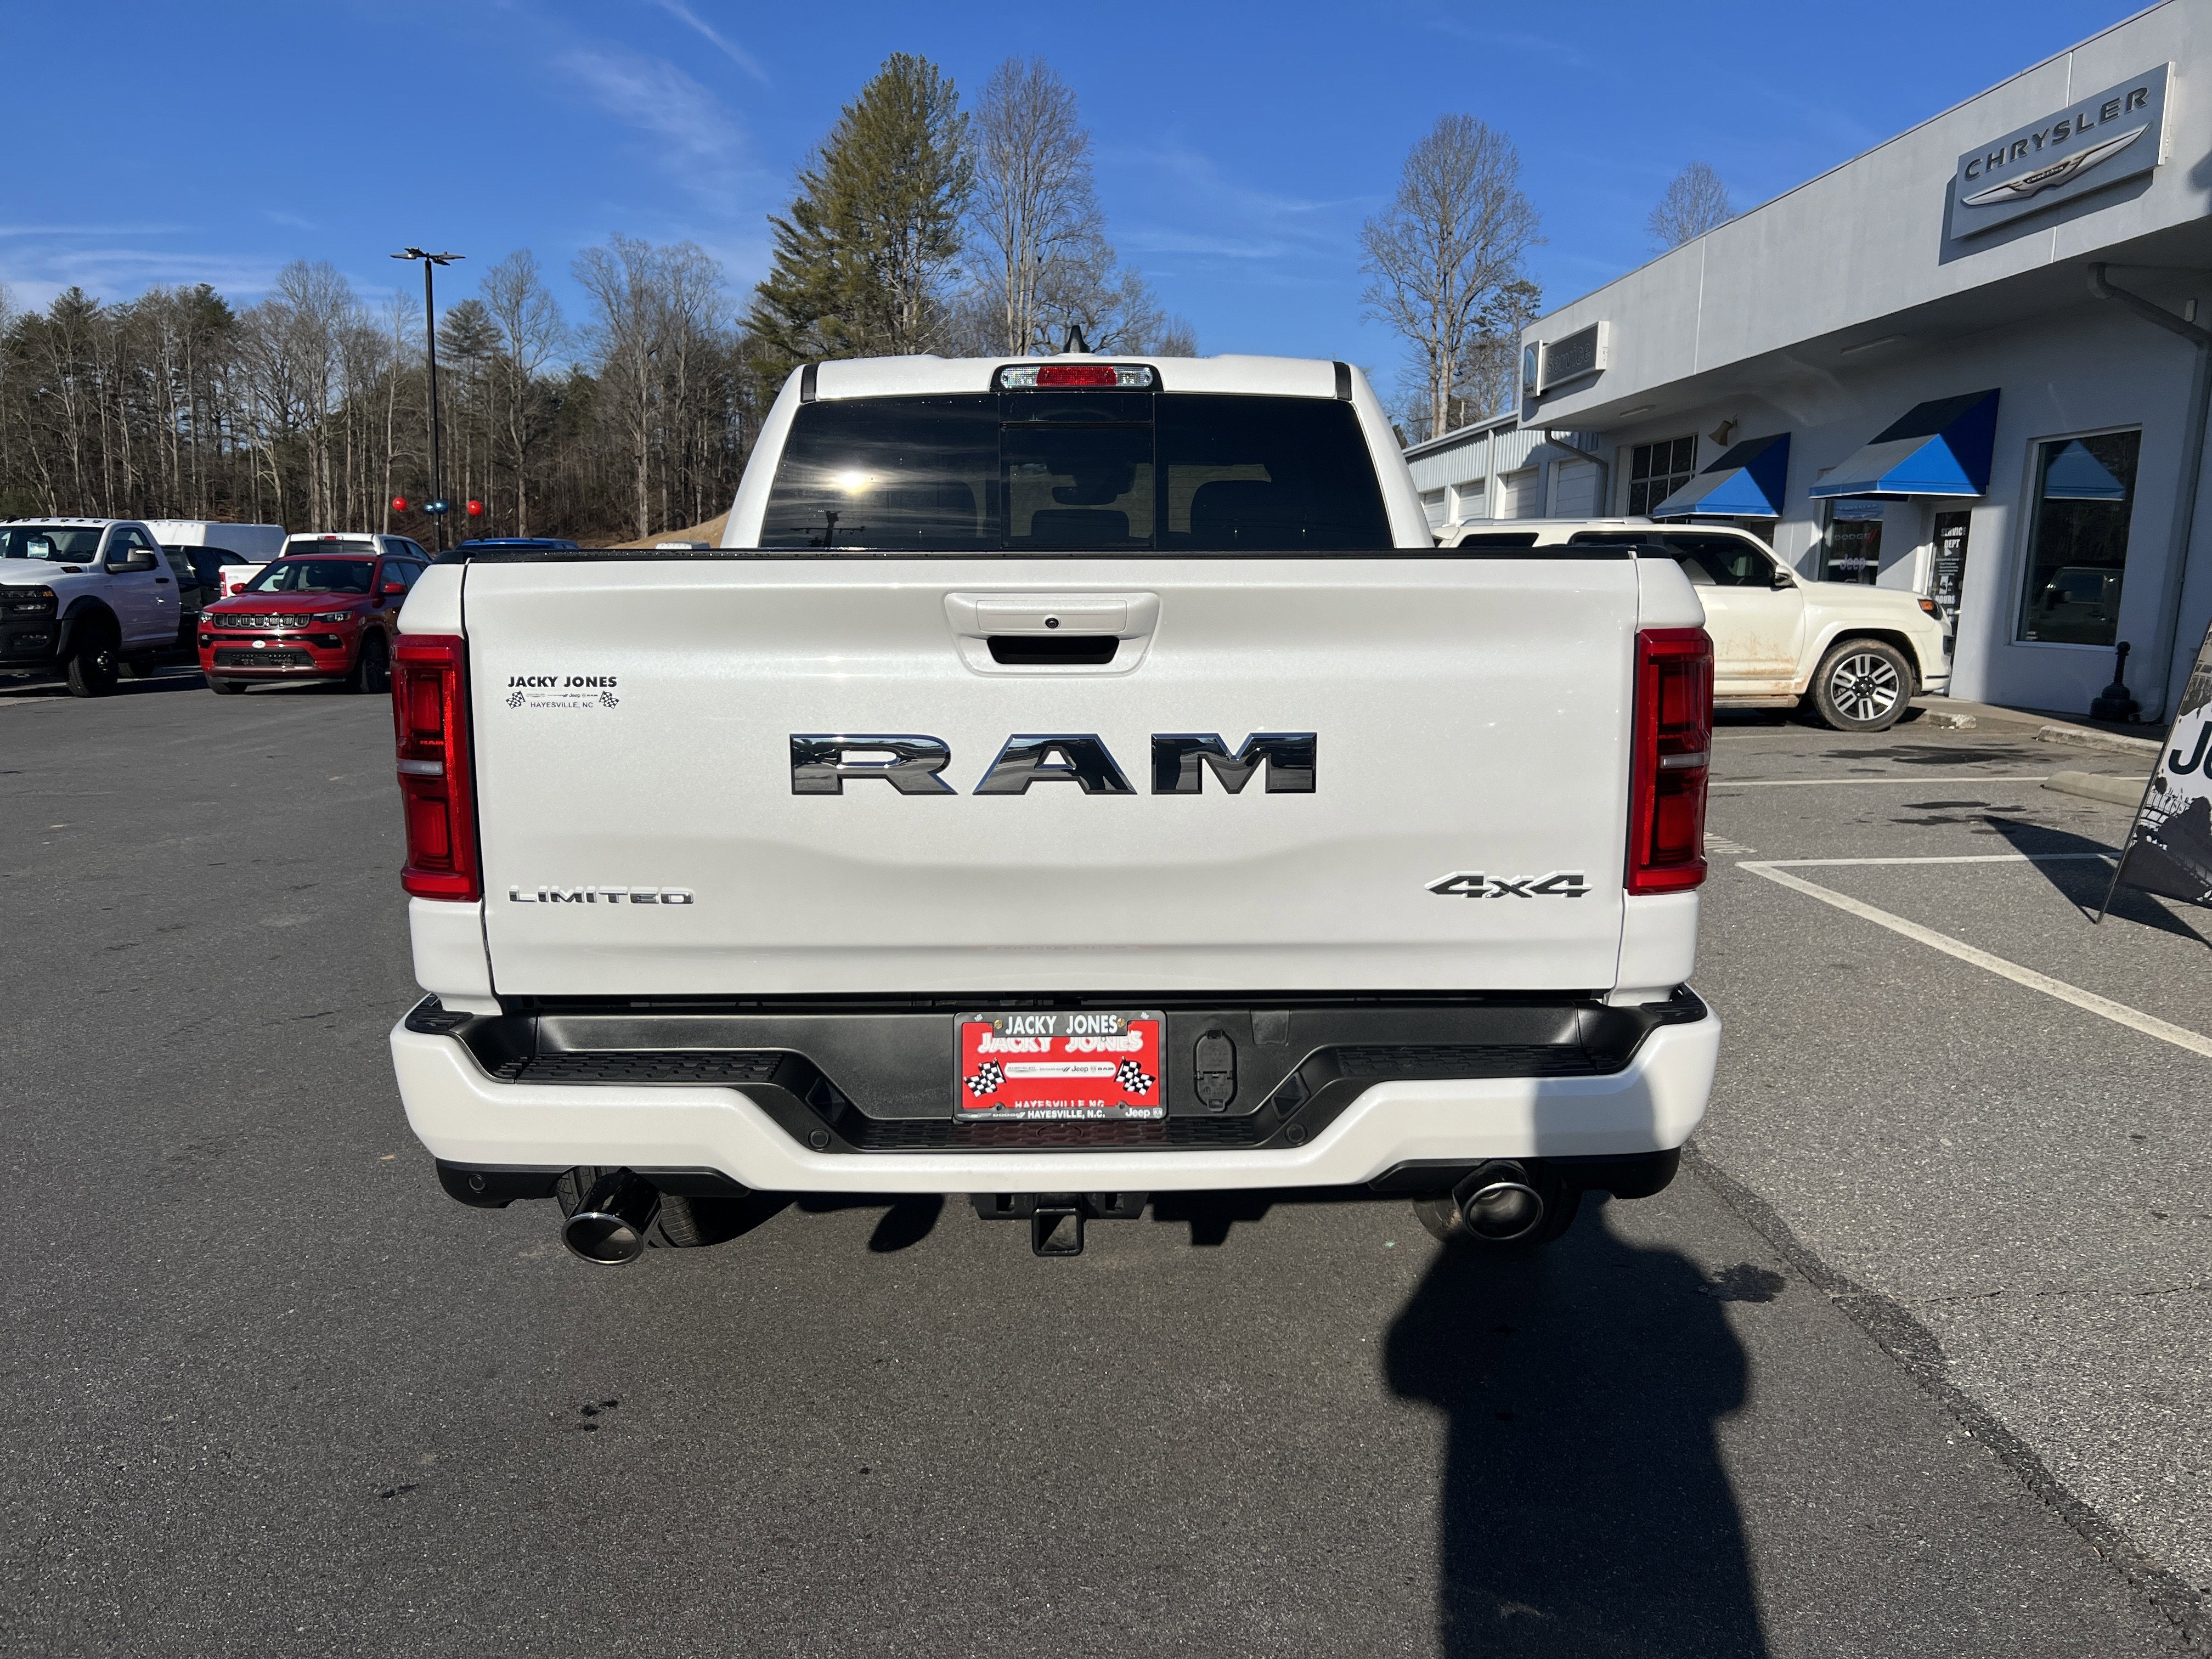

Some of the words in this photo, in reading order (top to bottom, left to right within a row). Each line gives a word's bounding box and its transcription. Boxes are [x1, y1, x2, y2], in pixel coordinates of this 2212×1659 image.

[1965, 87, 2150, 181] CHRYSLER
[1547, 343, 1591, 377] Service
[1944, 539, 1960, 548] DEPT
[1839, 553, 1866, 573] Jeep
[507, 676, 558, 687] JACKY
[563, 676, 617, 687] JONES
[789, 732, 1317, 795] RAM
[1425, 871, 1592, 898] 4x4
[509, 888, 695, 904] LIMITED
[1005, 1015, 1057, 1035] JACKY
[1066, 1014, 1118, 1034] JONES
[978, 1032, 1053, 1053] JACKY
[1065, 1030, 1143, 1053] JONES
[1028, 1109, 1085, 1119] HAYESVILLE,
[1087, 1109, 1105, 1119] N.C.
[1125, 1108, 1150, 1119] Jeep
